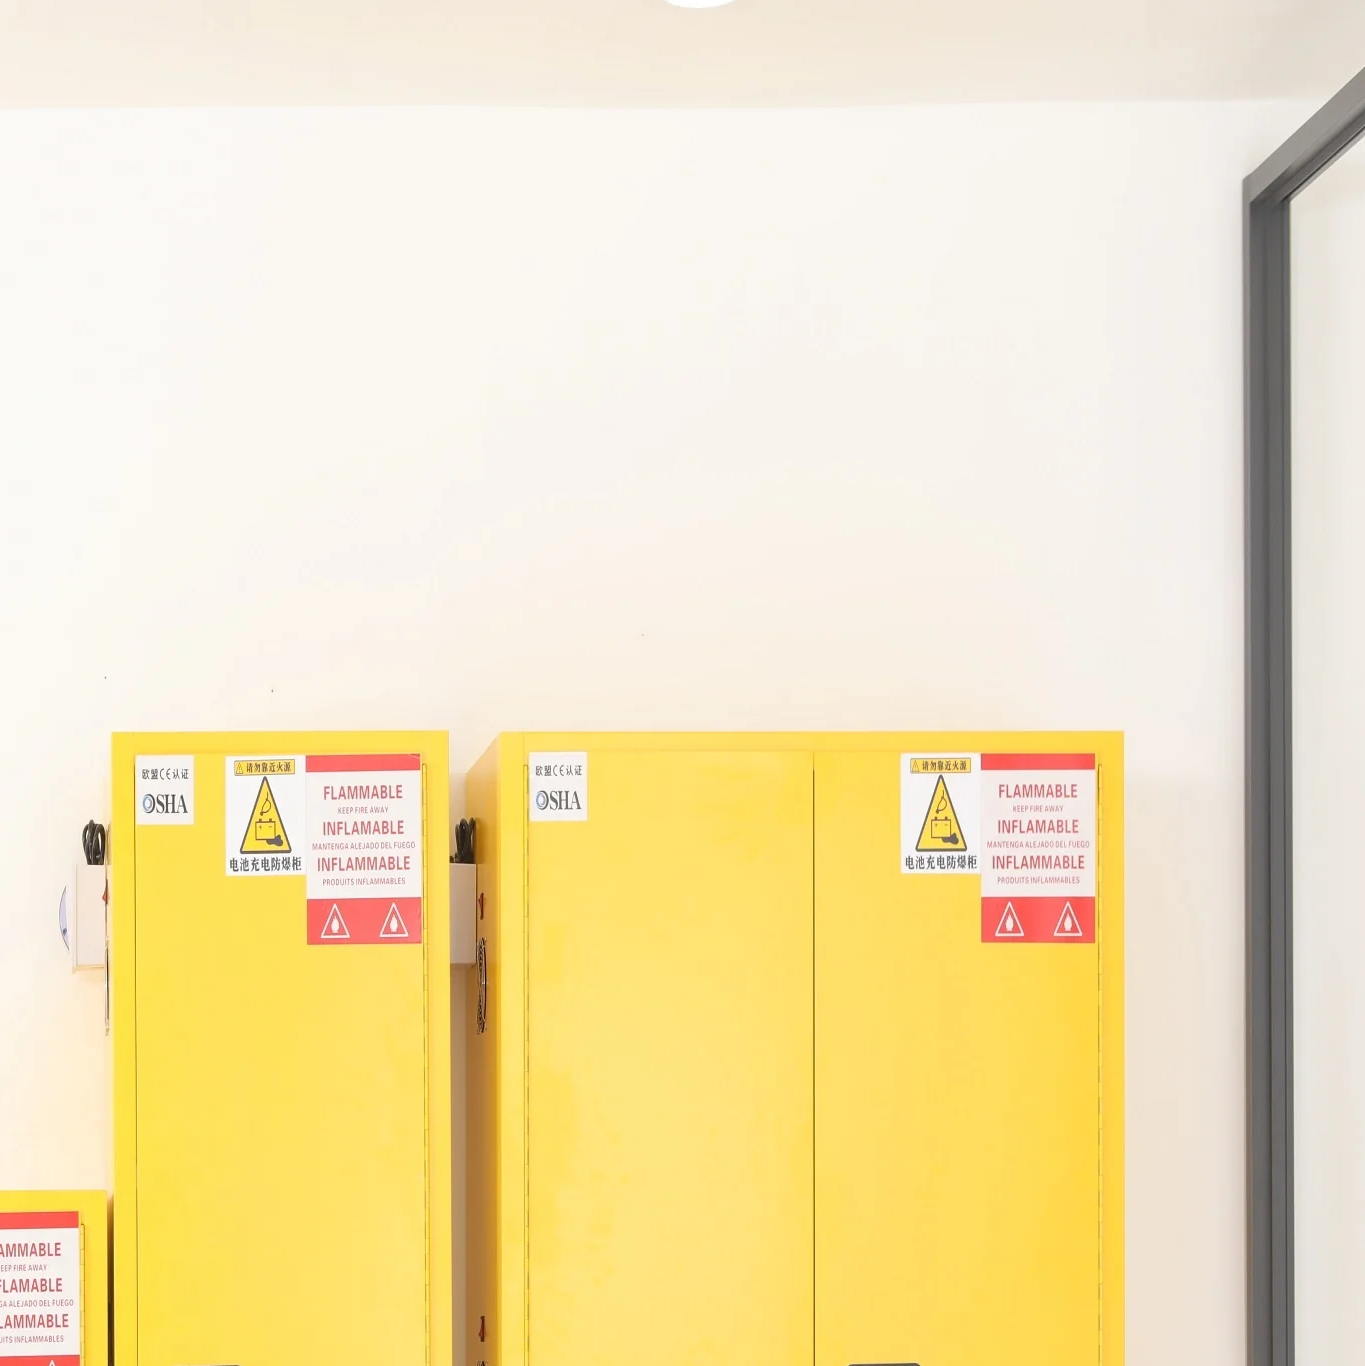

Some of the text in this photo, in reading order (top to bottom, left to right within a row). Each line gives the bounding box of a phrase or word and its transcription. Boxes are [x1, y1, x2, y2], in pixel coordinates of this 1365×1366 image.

[246, 761, 292, 773] 请勿靠近火源
[922, 760, 967, 771] 请勿靠近火源
[323, 784, 402, 800] FLAMMABLE
[998, 784, 1077, 798] FLAMMABLE
[142, 793, 188, 814] OSHA
[536, 790, 581, 810] OSHA
[338, 806, 354, 814] KEEP
[323, 820, 404, 835] INFLAMABLE
[998, 820, 1079, 834] INFLAMABLE
[312, 842, 349, 850] MANTENGA
[380, 841, 393, 849] DEL
[229, 856, 302, 872] 电池充电防爆柜
[317, 855, 410, 871] INFLAMMABLE
[905, 855, 977, 870] 电池充电防爆柜
[992, 855, 1085, 870] INFLAMMABLE
[356, 877, 405, 885] INFLAMMABLES
[39, 1299, 51, 1307] DEL
[14, 1335, 64, 1343] INFLAMMABLES
